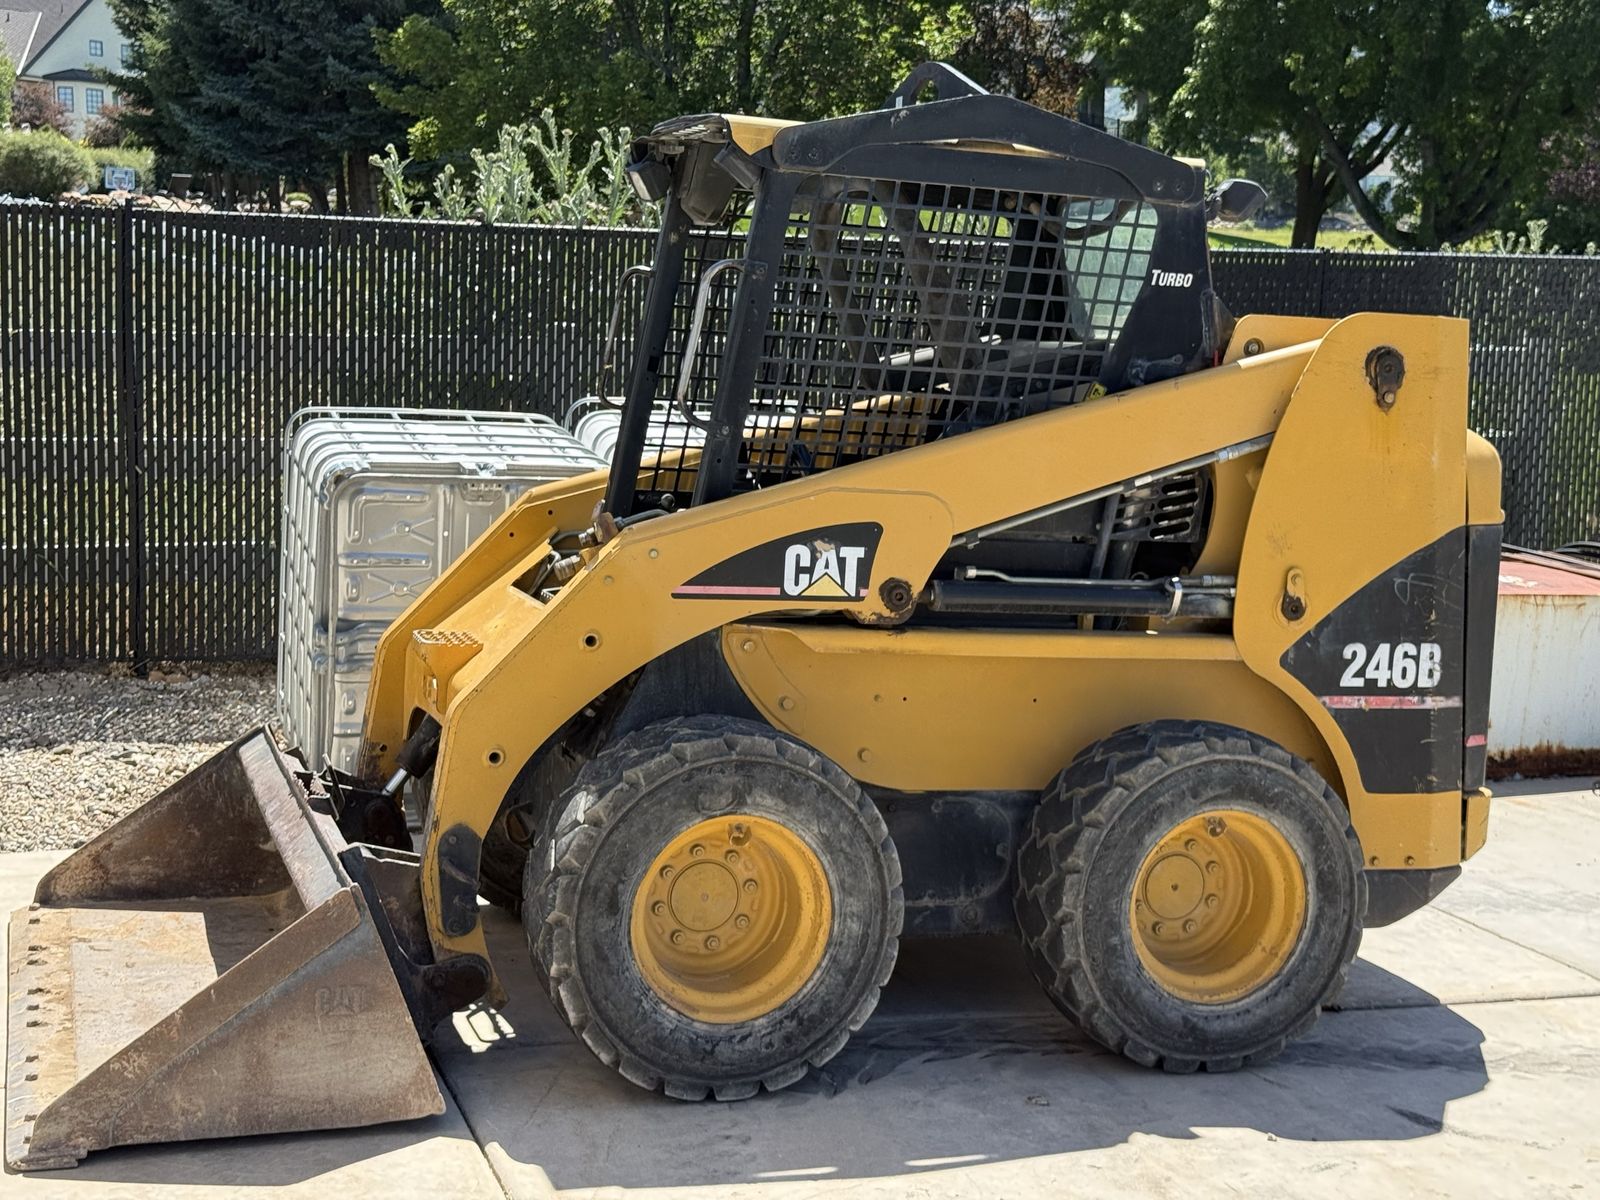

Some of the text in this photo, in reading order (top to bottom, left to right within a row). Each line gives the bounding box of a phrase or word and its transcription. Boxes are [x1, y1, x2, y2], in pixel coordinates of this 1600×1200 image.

[1151, 269, 1193, 288] TURBO
[783, 544, 865, 597] CAT
[1339, 642, 1442, 689] 246B
